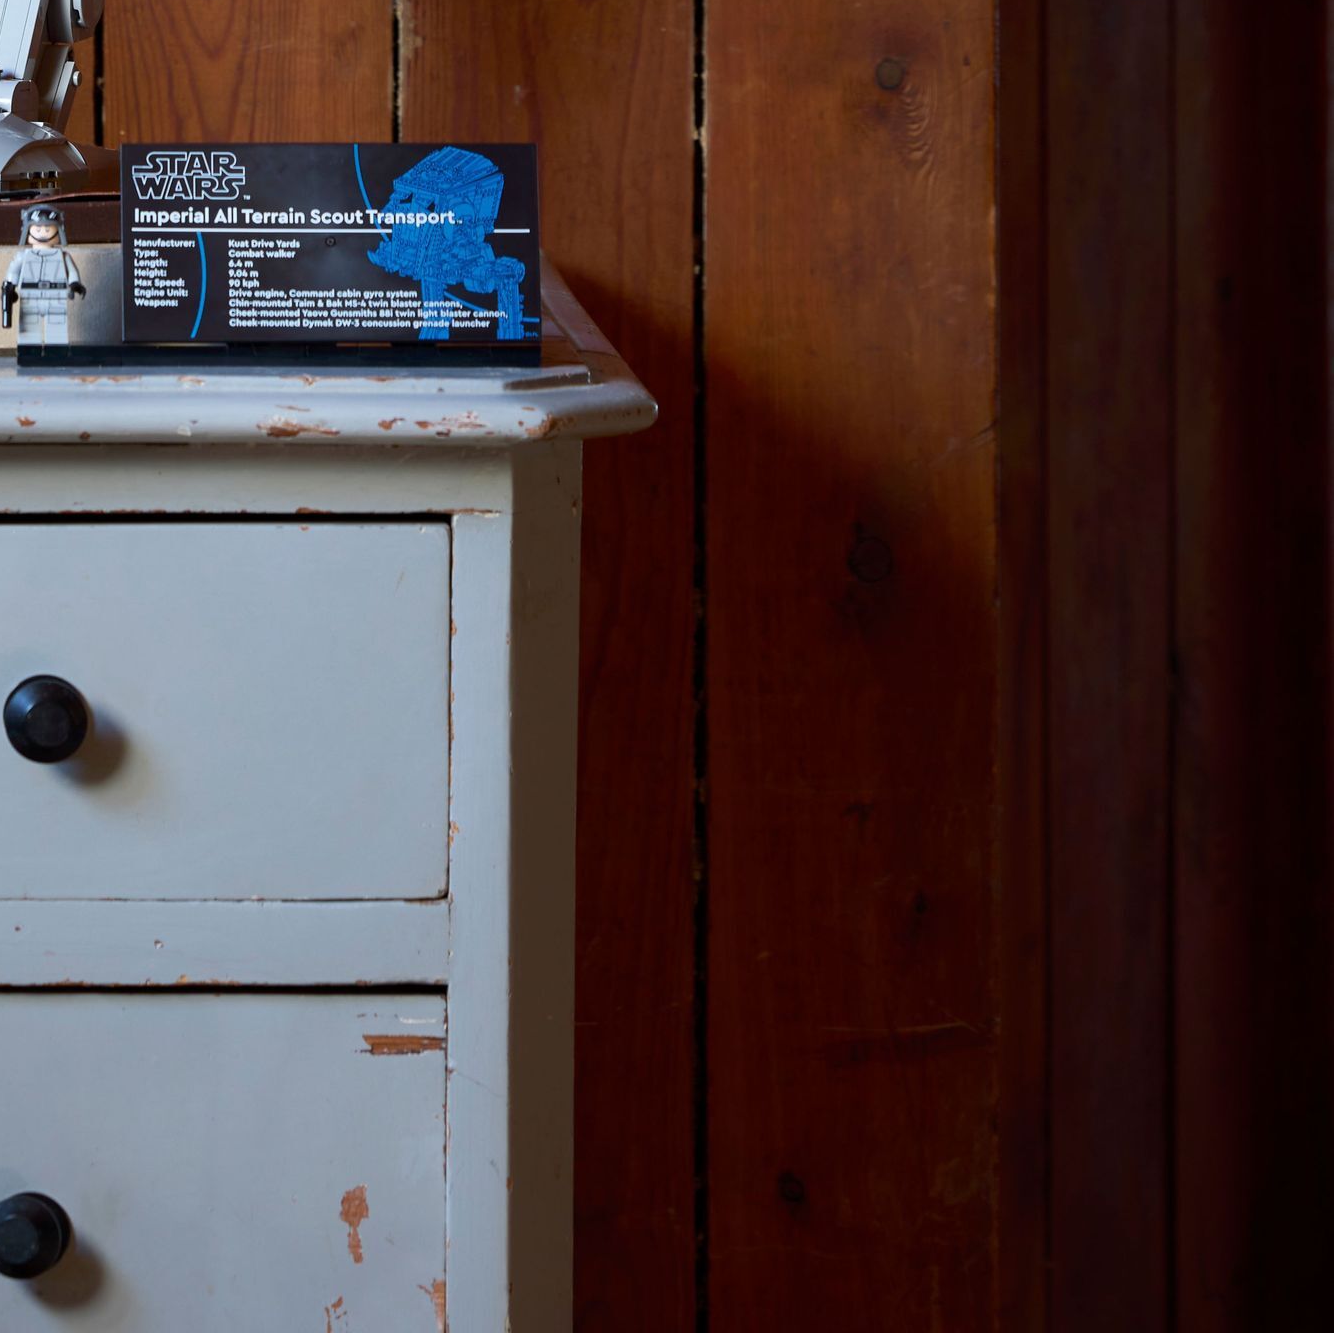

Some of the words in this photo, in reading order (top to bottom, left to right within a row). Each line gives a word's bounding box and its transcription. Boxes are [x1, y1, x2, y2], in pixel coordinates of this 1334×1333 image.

[132, 151, 245, 176] STAR
[132, 174, 246, 200] WARS
[134, 207, 209, 226] Imperial
[214, 207, 237, 224] All
[241, 207, 305, 224] Terrain
[310, 209, 364, 224] Scout
[366, 209, 455, 227] Transport
[134, 238, 195, 247] Manufacturer:
[228, 239, 249, 248] Kuat
[251, 239, 274, 248] Drive
[276, 239, 300, 248] Yards
[134, 248, 158, 258] Type:
[228, 249, 264, 258] Combat
[266, 249, 296, 258] walker
[134, 258, 167, 268] Length:
[228, 259, 243, 267] 6.4
[134, 268, 167, 278] Height:
[134, 278, 153, 286] Max
[154, 278, 185, 288] Speed:
[228, 279, 240, 287] 90
[242, 279, 260, 289] kph
[134, 287, 165, 298] Engine
[166, 288, 188, 297] Unit:
[228, 288, 252, 297] Drive
[254, 288, 287, 299] engine,
[289, 288, 335, 297] Command
[336, 289, 362, 298] cabin
[363, 290, 384, 299] gyro
[386, 290, 417, 299] system
[134, 298, 178, 308] Weapons:
[228, 298, 292, 307] Chin-mounted
[294, 299, 316, 308] Taim
[317, 299, 324, 308] &
[326, 299, 343, 308] Bak
[344, 299, 367, 308] MS-4
[368, 299, 388, 308] twin
[390, 299, 422, 308] blaster
[423, 300, 463, 309] cannons,
[228, 308, 301, 317] Cheek-mounted
[330, 308, 378, 318] Gunsmiths
[395, 309, 415, 318] twin
[417, 309, 438, 319] light
[440, 309, 471, 318] blaster
[472, 310, 509, 319] cannon,
[228, 318, 301, 327] Cheek-mounted
[302, 318, 334, 329] Dymek
[335, 319, 360, 328] DW-3
[361, 318, 411, 328] concussion
[412, 319, 450, 329] grenade
[451, 319, 490, 328] launcher
